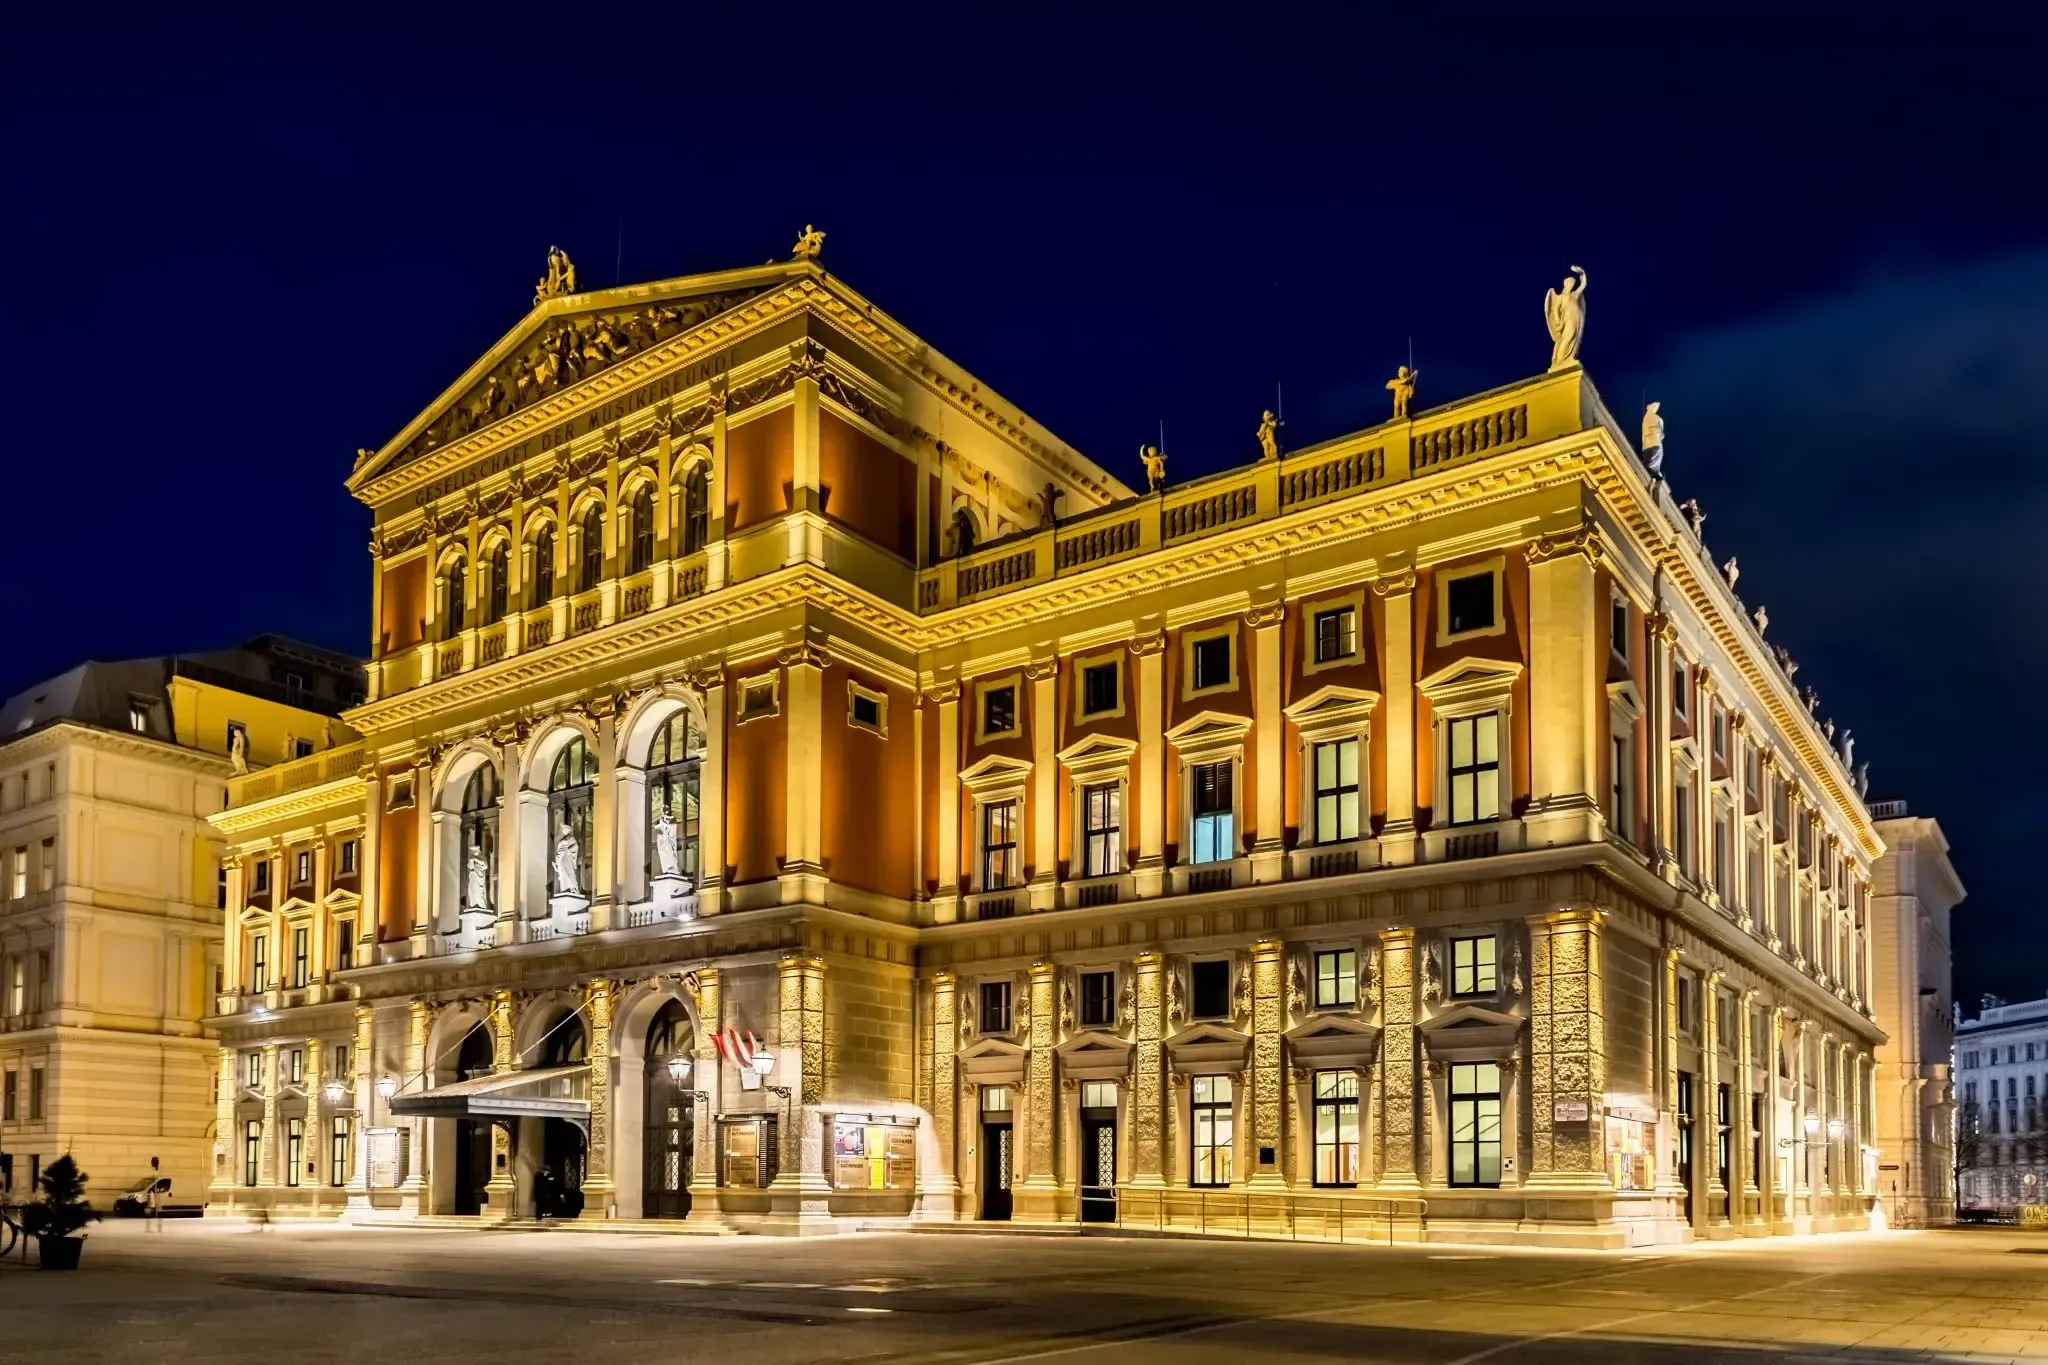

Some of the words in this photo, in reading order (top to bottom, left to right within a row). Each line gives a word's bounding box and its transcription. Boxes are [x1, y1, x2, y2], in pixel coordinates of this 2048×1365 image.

[415, 444, 530, 506] GESELLSCHAFT
[541, 422, 576, 451] DER
[588, 349, 738, 431] MUSIKFREUNDE
